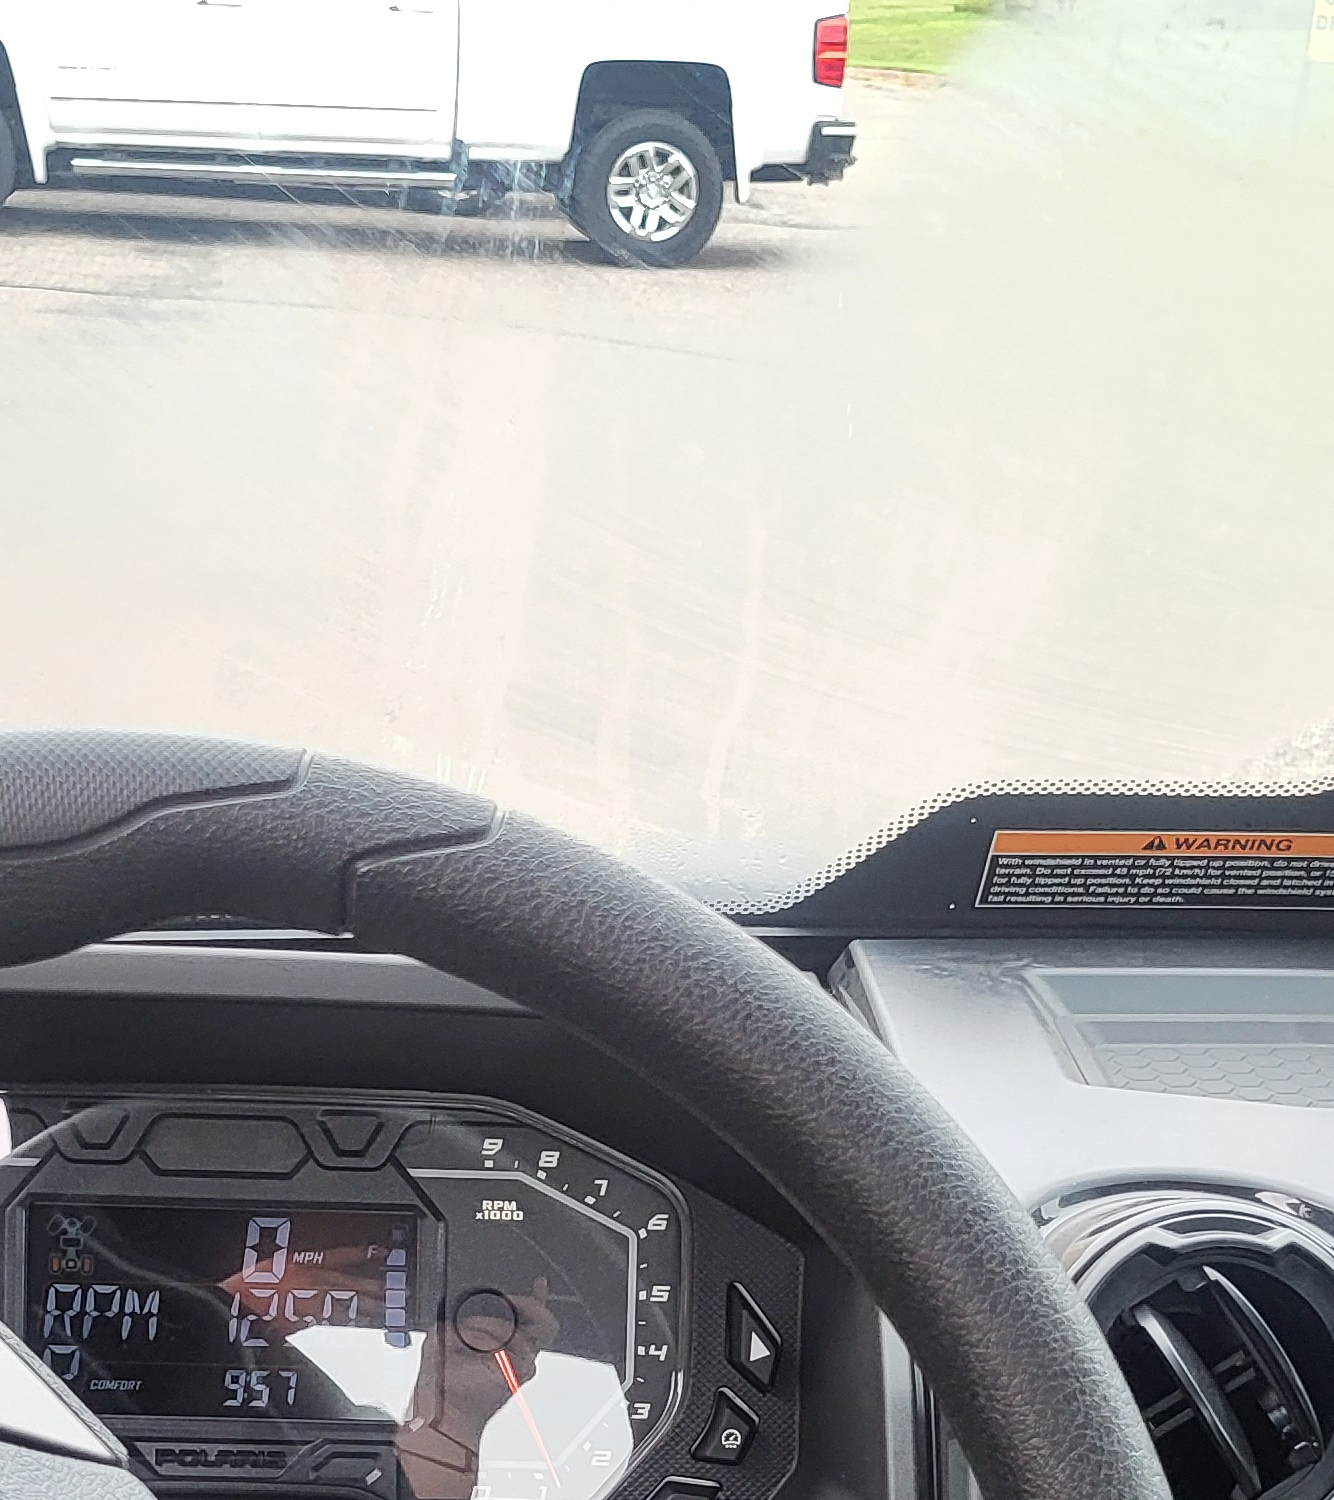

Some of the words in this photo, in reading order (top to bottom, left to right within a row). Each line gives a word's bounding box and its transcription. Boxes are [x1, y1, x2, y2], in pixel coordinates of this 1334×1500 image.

[1175, 837, 1294, 851] WARNING
[480, 1138, 504, 1156] 9
[538, 1150, 561, 1168] 8
[593, 1179, 609, 1197] 7
[481, 1199, 518, 1211] RPM
[474, 1210, 524, 1221] x1000
[646, 1213, 670, 1231] 6
[242, 1216, 291, 1284] 0
[292, 1251, 324, 1265] MPH
[367, 1245, 378, 1259] F
[649, 1285, 672, 1302] 5
[43, 1283, 161, 1341] RPM
[647, 1344, 669, 1362] 4
[90, 1379, 143, 1392] COMFORT
[630, 1402, 652, 1420] 3
[154, 1448, 288, 1469] POLARIS
[590, 1451, 612, 1467] 2
[538, 1485, 548, 1500] 1
